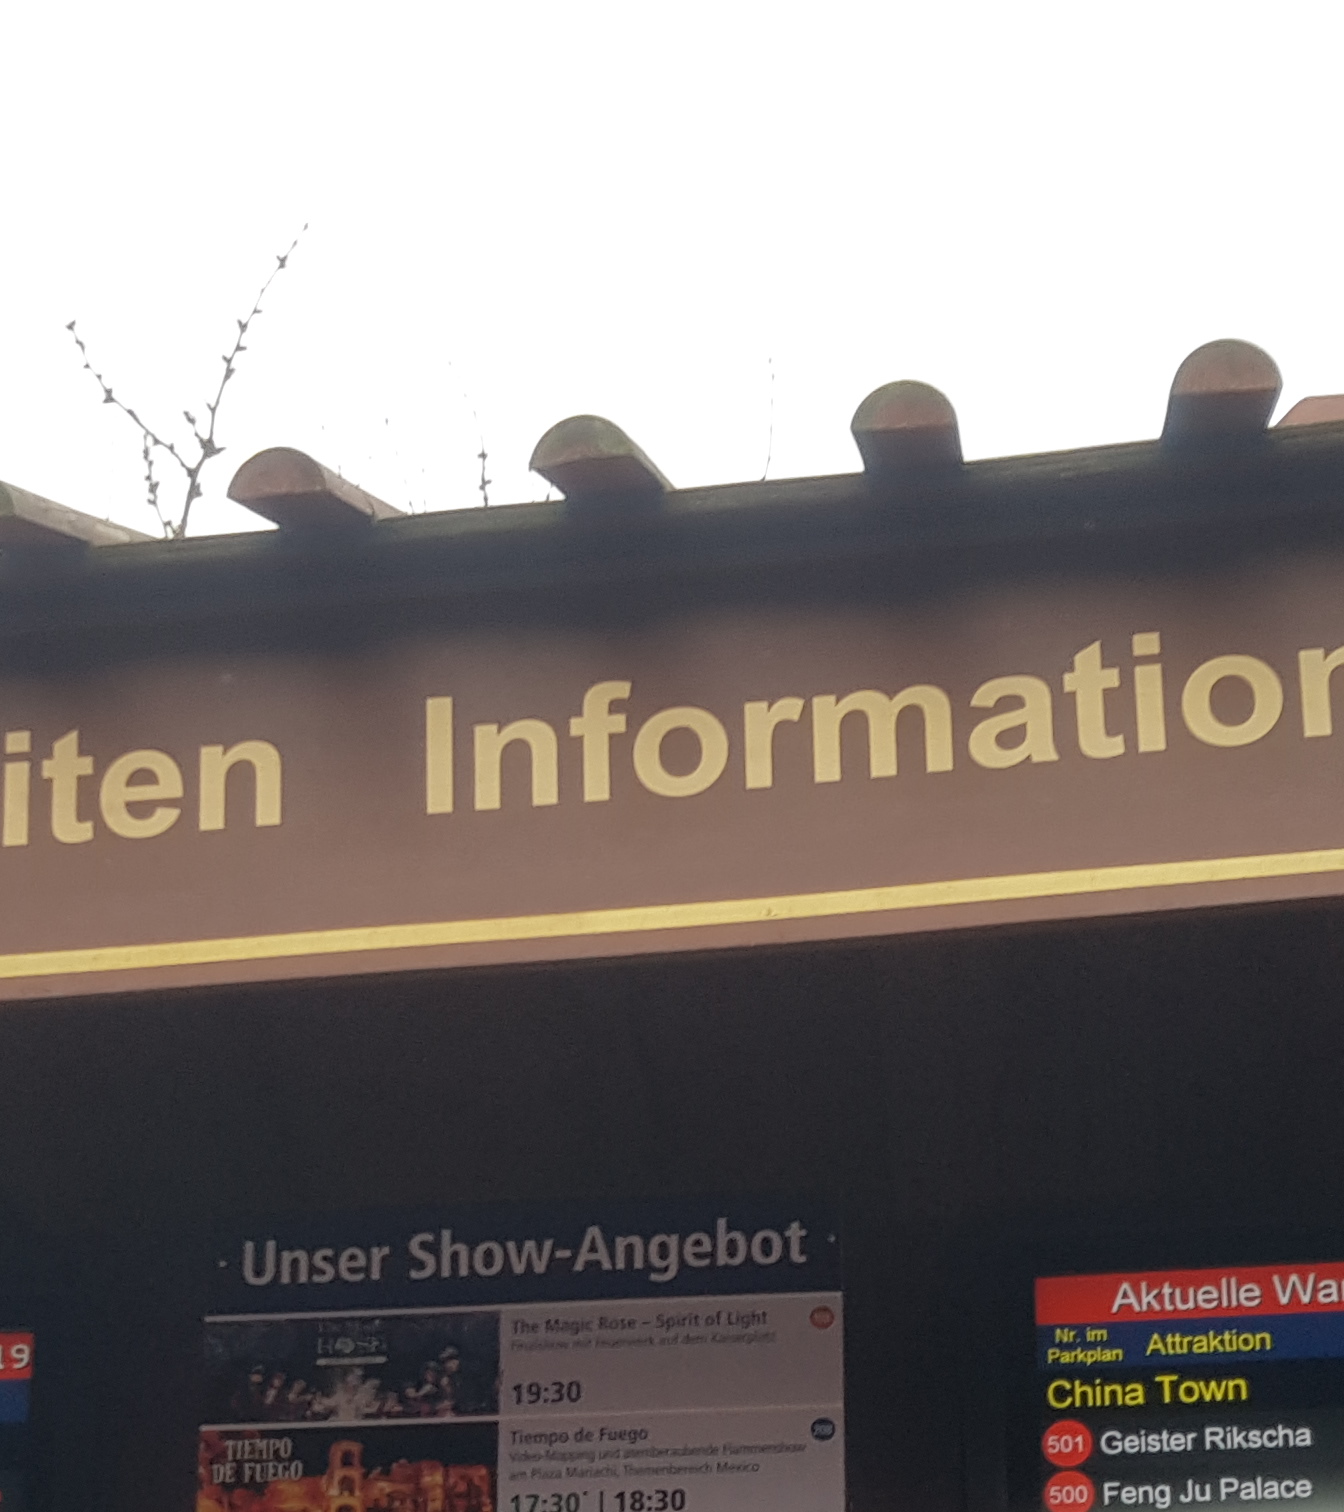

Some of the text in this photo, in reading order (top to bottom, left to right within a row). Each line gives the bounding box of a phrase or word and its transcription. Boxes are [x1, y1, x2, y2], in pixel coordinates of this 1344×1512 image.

[243, 1218, 806, 1285] Unser Show-Angebot
[1112, 1278, 1260, 1312] Aktuelle
[1146, 1330, 1270, 1355] Attraktion
[513, 1381, 581, 1405] 19:30
[1048, 1375, 1247, 1408] China Town
[1048, 1435, 1082, 1453] 501
[1101, 1430, 1197, 1454] Geister
[1205, 1425, 1311, 1449] Rikscha
[615, 1489, 685, 1512] 18:30
[1050, 1485, 1087, 1504] 500
[1104, 1482, 1170, 1509] Feng
[1180, 1480, 1211, 1503] Ju
[1221, 1477, 1312, 1500] Palace
